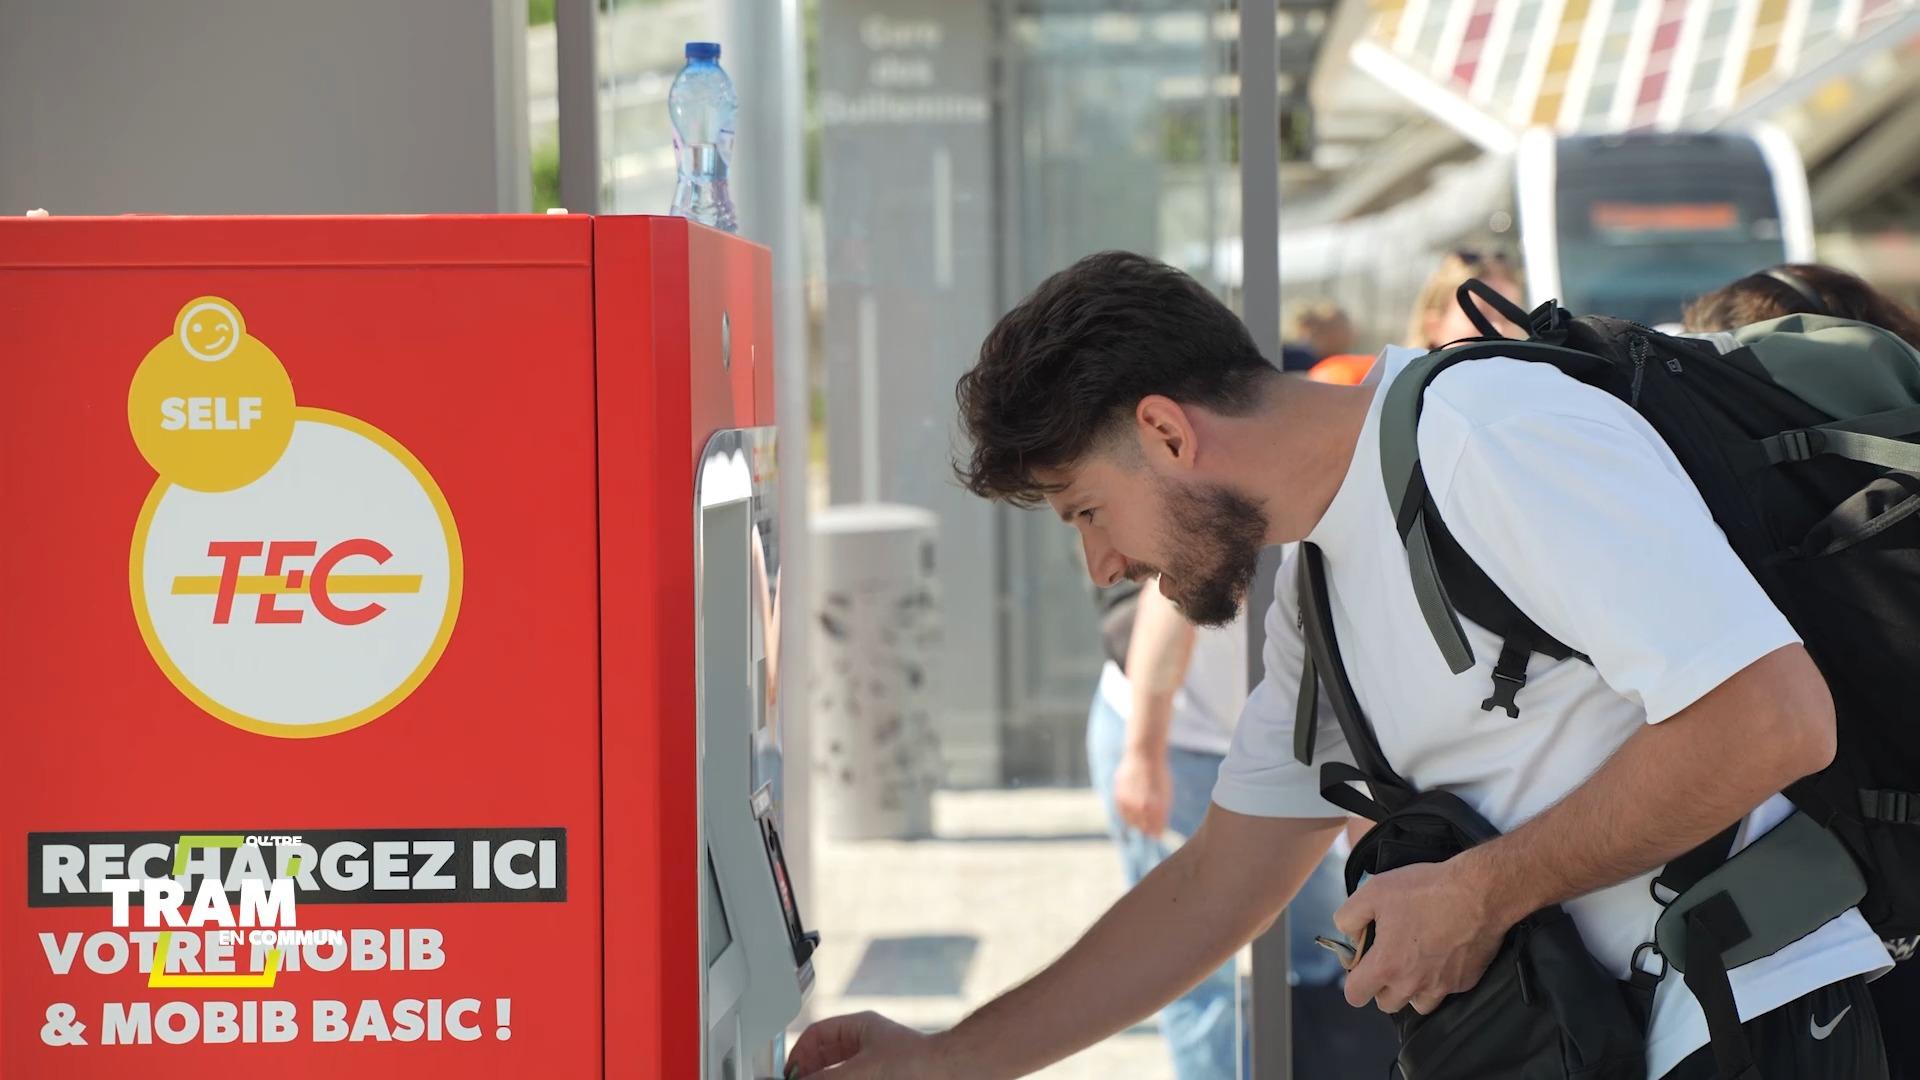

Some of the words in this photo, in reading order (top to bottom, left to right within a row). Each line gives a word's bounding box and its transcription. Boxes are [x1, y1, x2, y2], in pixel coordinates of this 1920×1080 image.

[160, 396, 262, 431] SELF
[207, 538, 394, 626] TEC
[42, 841, 457, 894] RECHARGEZ
[472, 839, 557, 890] ICI
[38, 930, 237, 976] VOTRE
[249, 928, 446, 973] MOBIB
[39, 1002, 89, 1047] &
[100, 1000, 300, 1046] MOBIB
[312, 998, 483, 1043] BASIC
[494, 997, 512, 1042] !
